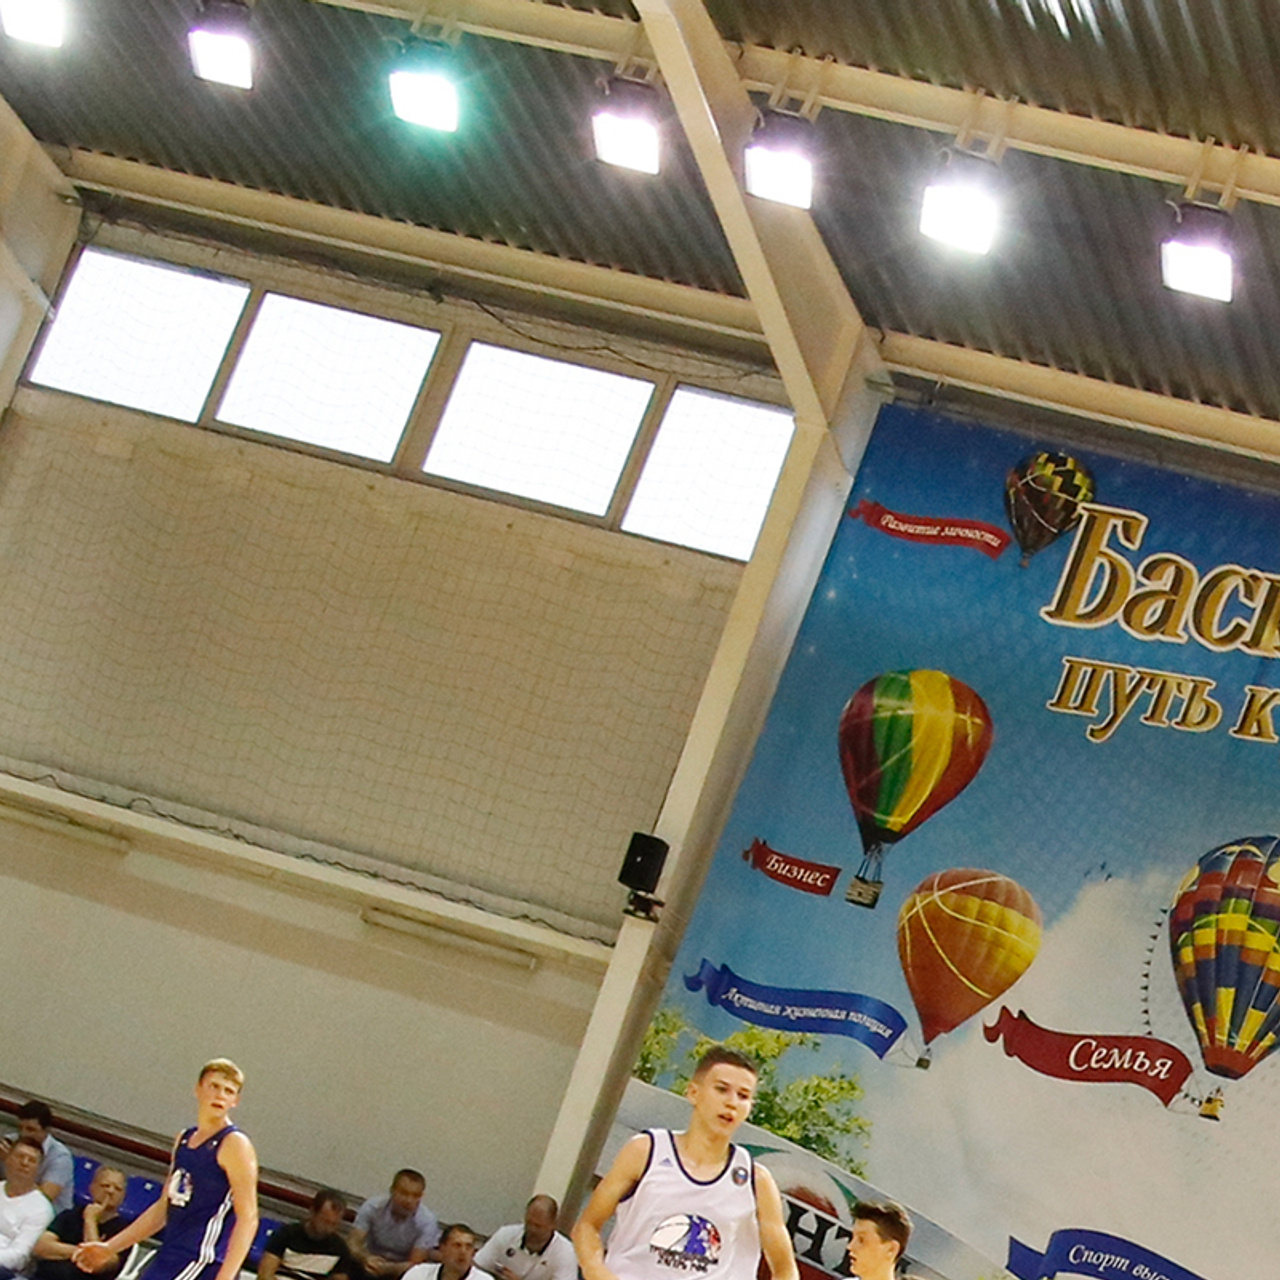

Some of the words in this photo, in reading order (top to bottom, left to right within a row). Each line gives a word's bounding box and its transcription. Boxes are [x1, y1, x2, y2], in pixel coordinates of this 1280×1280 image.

[1046, 656, 1224, 744] путь
[766, 854, 830, 887] Бизнес
[1067, 1039, 1174, 1082] Семья
[1068, 1244, 1130, 1271] Спорт
